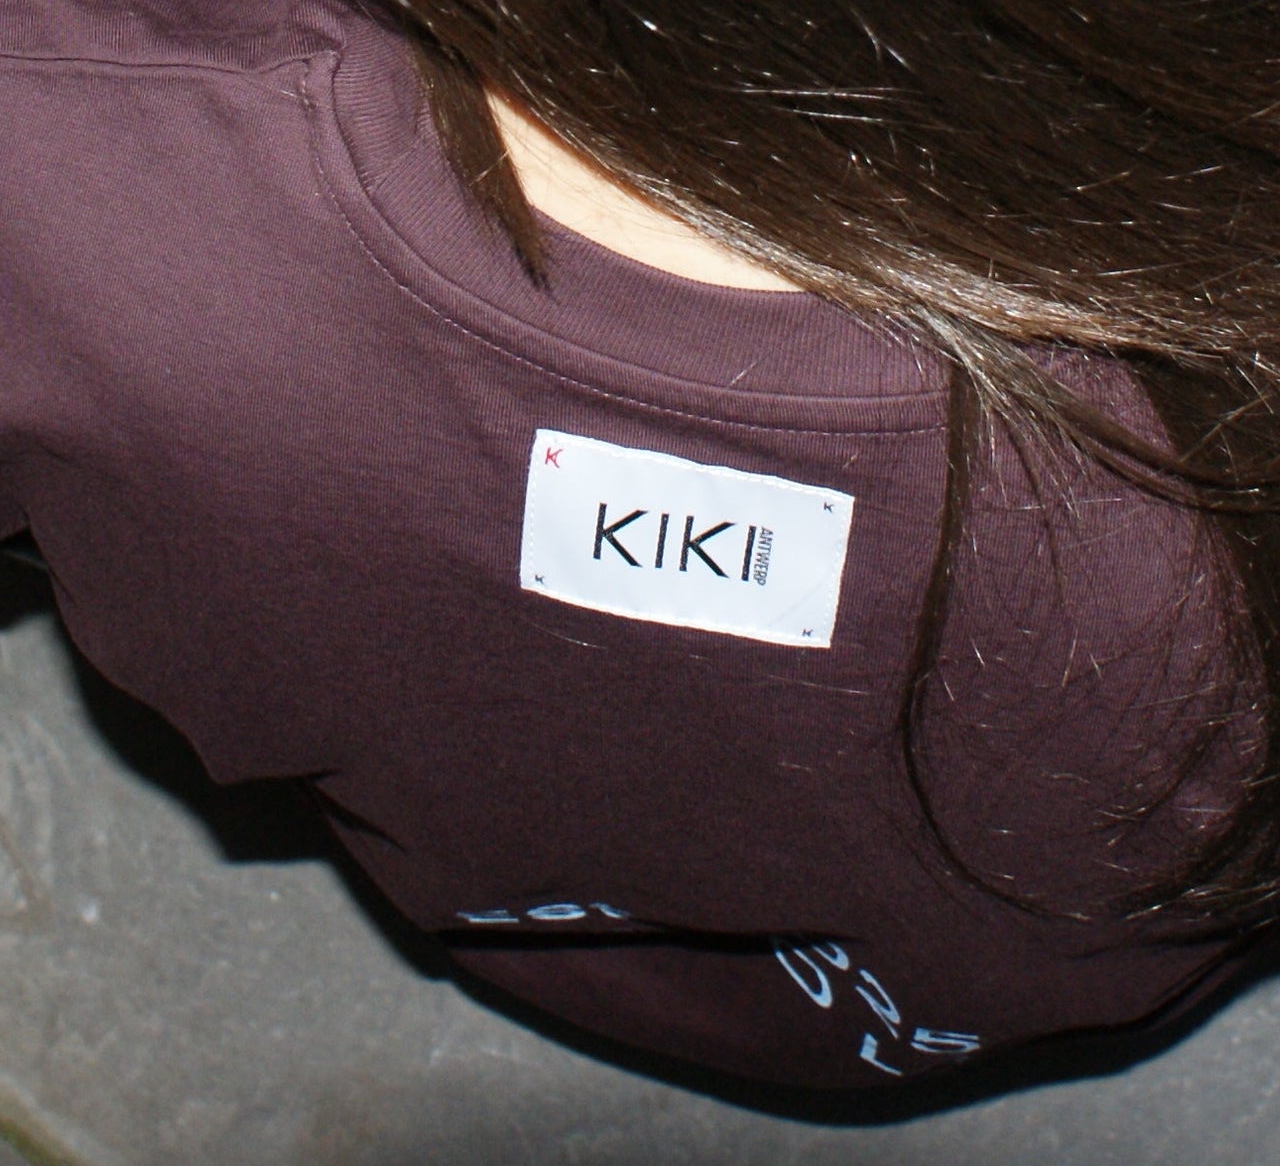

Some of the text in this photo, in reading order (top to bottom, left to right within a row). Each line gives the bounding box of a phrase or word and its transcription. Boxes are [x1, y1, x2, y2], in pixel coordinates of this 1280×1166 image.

[545, 447, 563, 469] K
[592, 501, 757, 582] KIKI
[753, 526, 774, 586] ANTWERP
